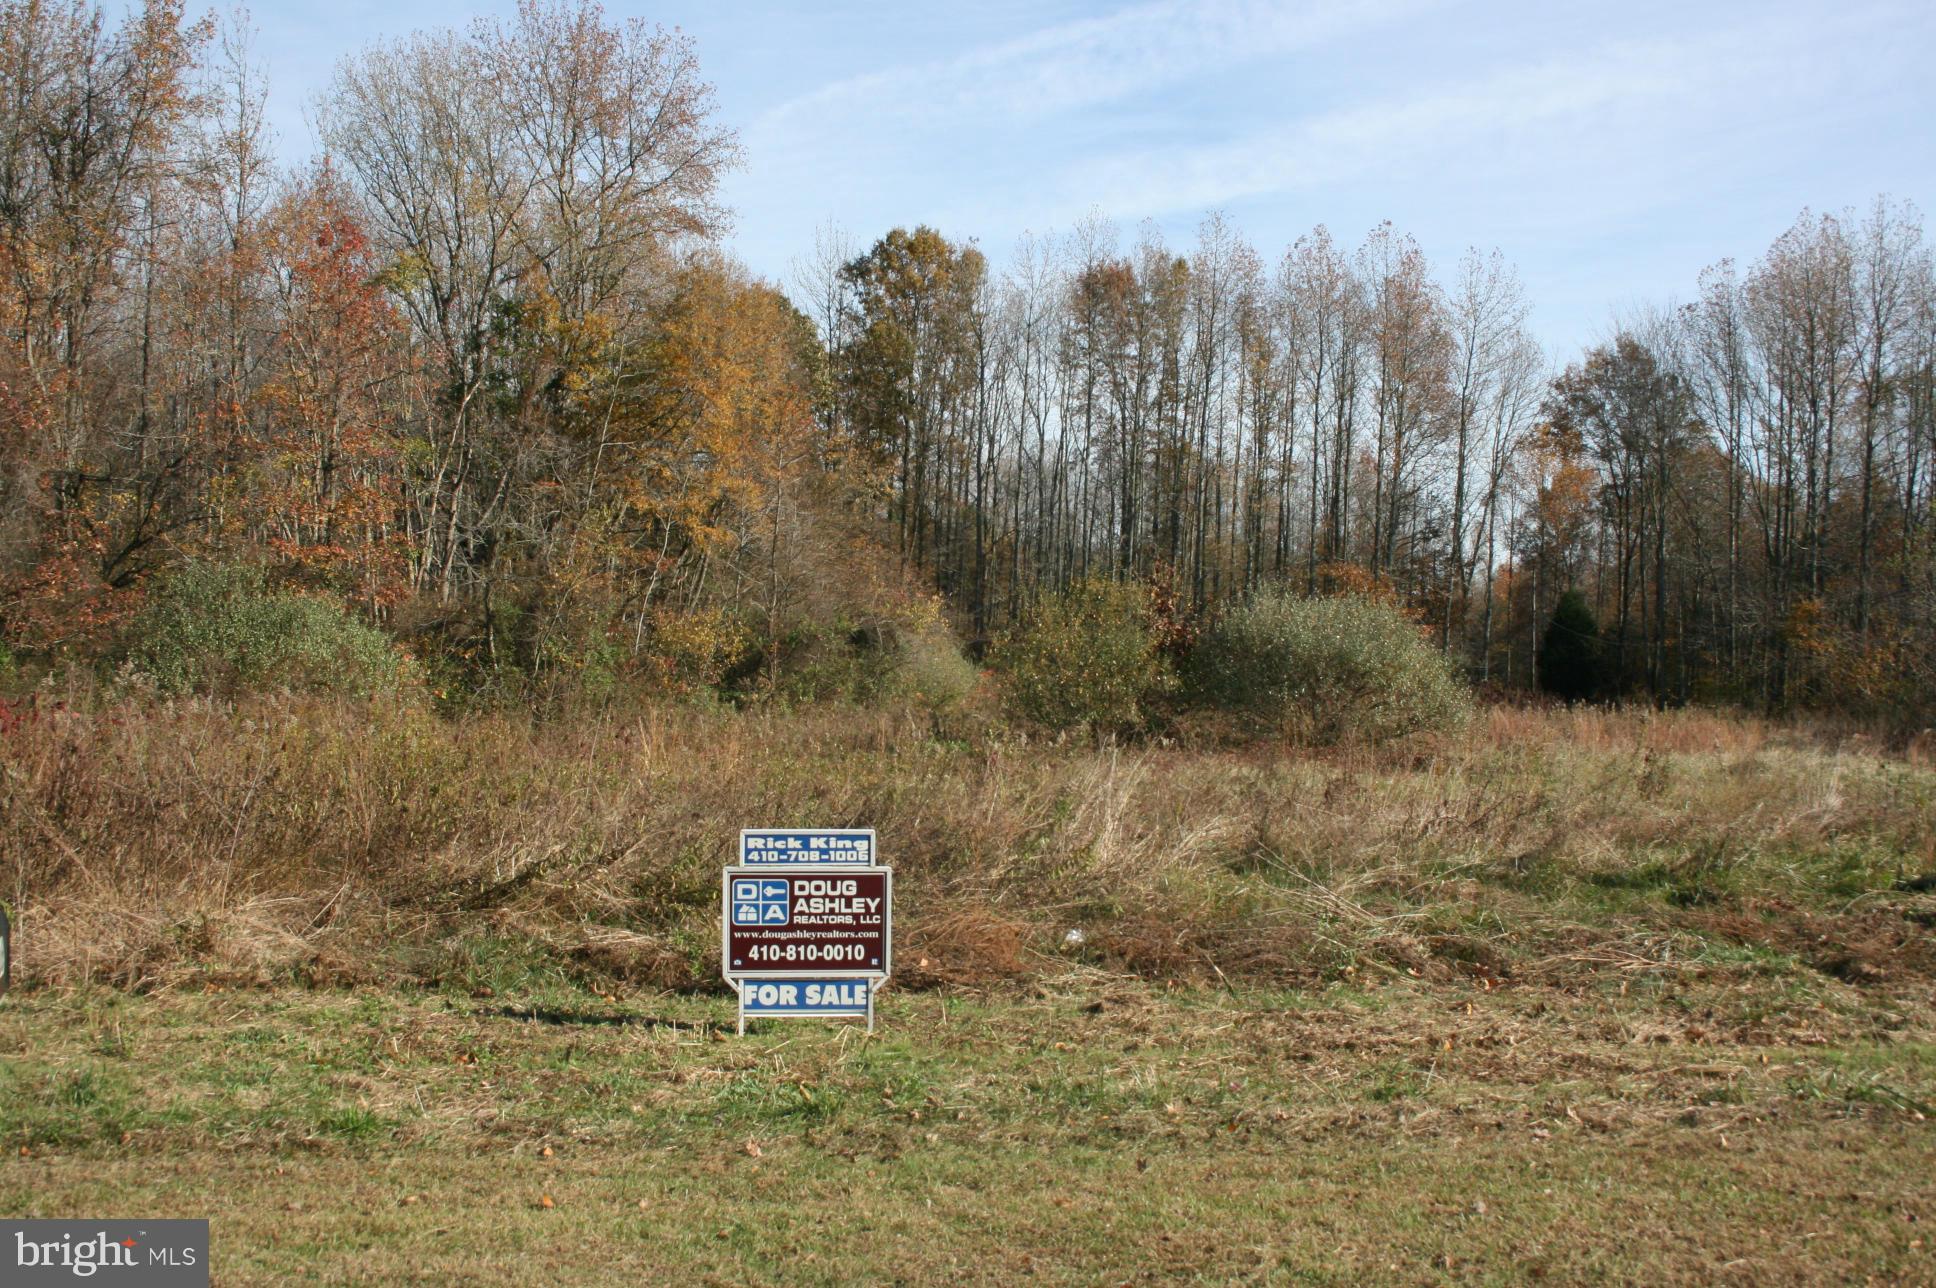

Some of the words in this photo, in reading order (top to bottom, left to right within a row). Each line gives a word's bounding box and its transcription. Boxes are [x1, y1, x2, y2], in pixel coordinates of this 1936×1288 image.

[747, 837, 803, 849] Rick
[809, 837, 869, 850] King
[736, 883, 758, 900] D
[793, 880, 857, 896] DOUG
[763, 904, 786, 921] A
[793, 897, 881, 913] ASHLEY
[793, 915, 857, 926] REALTORS,
[860, 915, 881, 924] LLC
[734, 930, 879, 940] www.dougashleyrealtors.com
[748, 944, 865, 961] 410-810-0010
[744, 984, 798, 1006] FOR
[805, 984, 867, 1006] SALE
